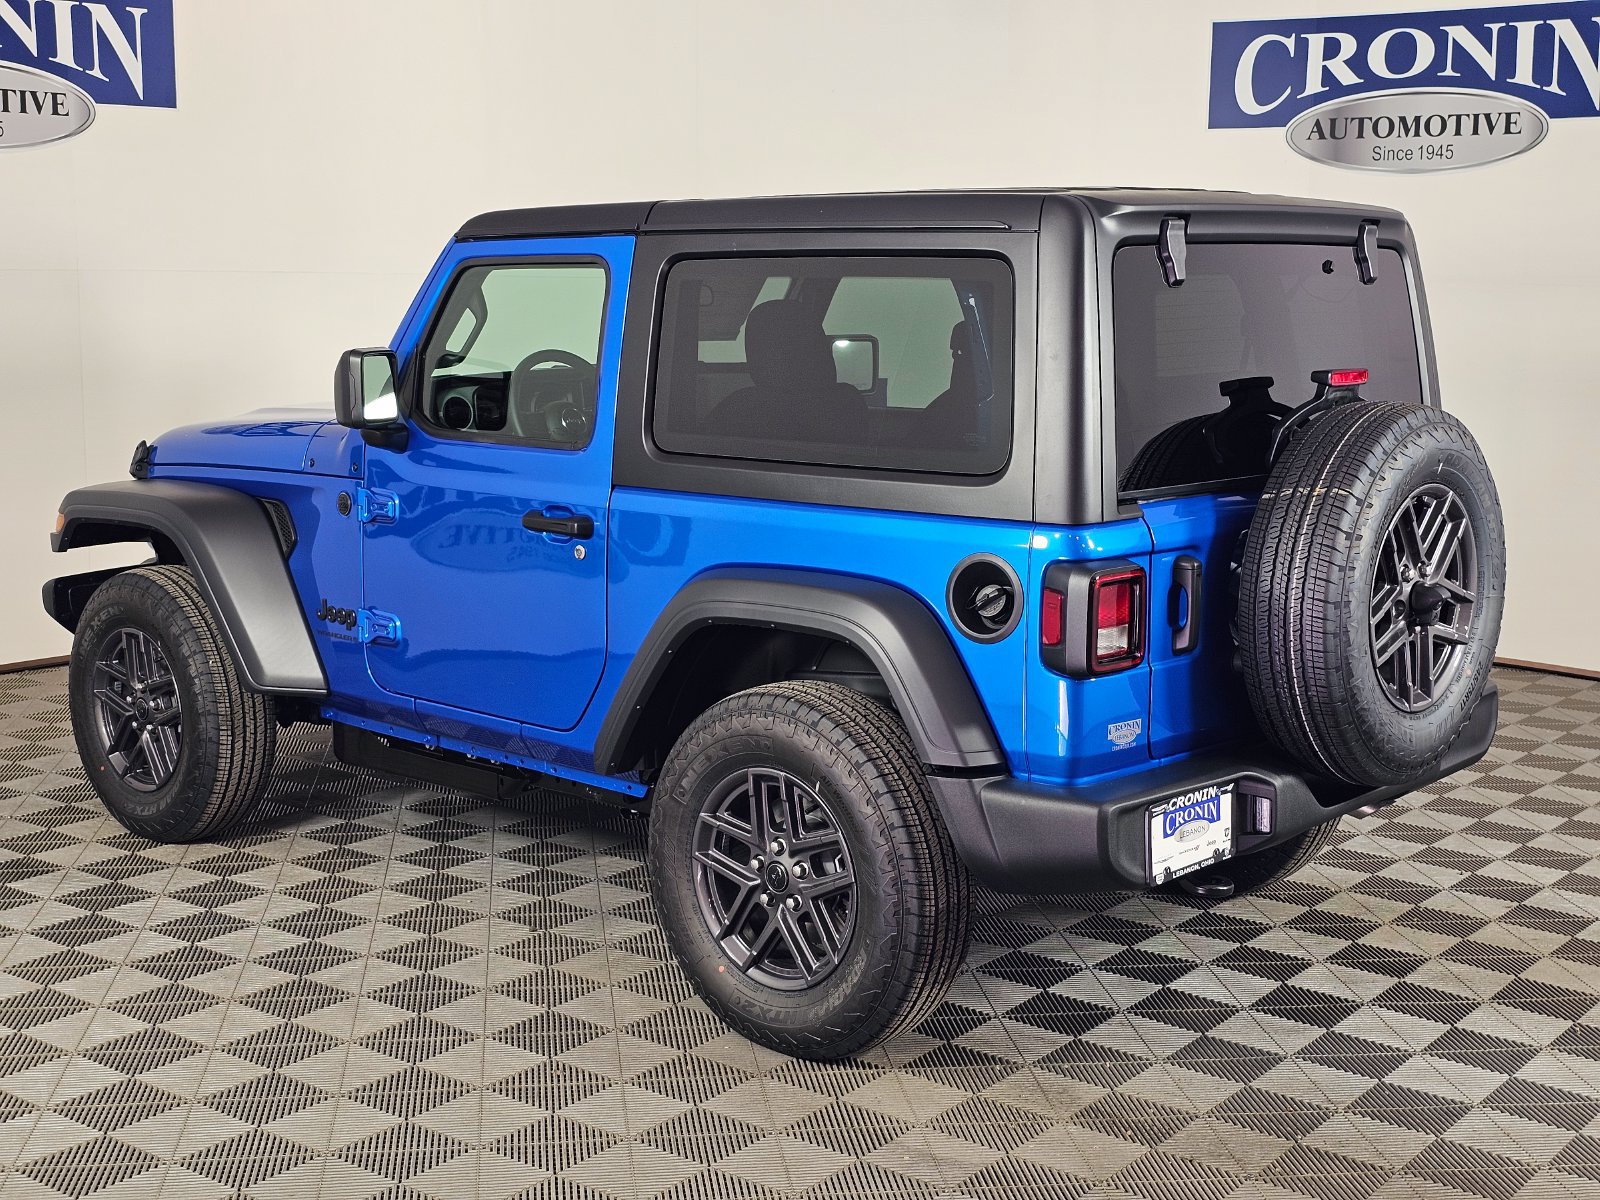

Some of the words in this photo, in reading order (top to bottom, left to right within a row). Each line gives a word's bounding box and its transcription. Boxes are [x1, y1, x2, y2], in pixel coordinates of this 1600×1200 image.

[1234, 17, 1600, 116] CRONIN
[0, 89, 69, 116] TIVE
[1306, 112, 1522, 141] AUTOMOTIVE
[1372, 146, 1413, 161] Since
[1417, 144, 1454, 160] 1945
[316, 598, 357, 631] Jeep
[1109, 721, 1141, 736] CRONIN
[1168, 786, 1217, 811] CRONIN
[1166, 800, 1218, 835] CRONIN
[1180, 825, 1206, 839] LEBANON
